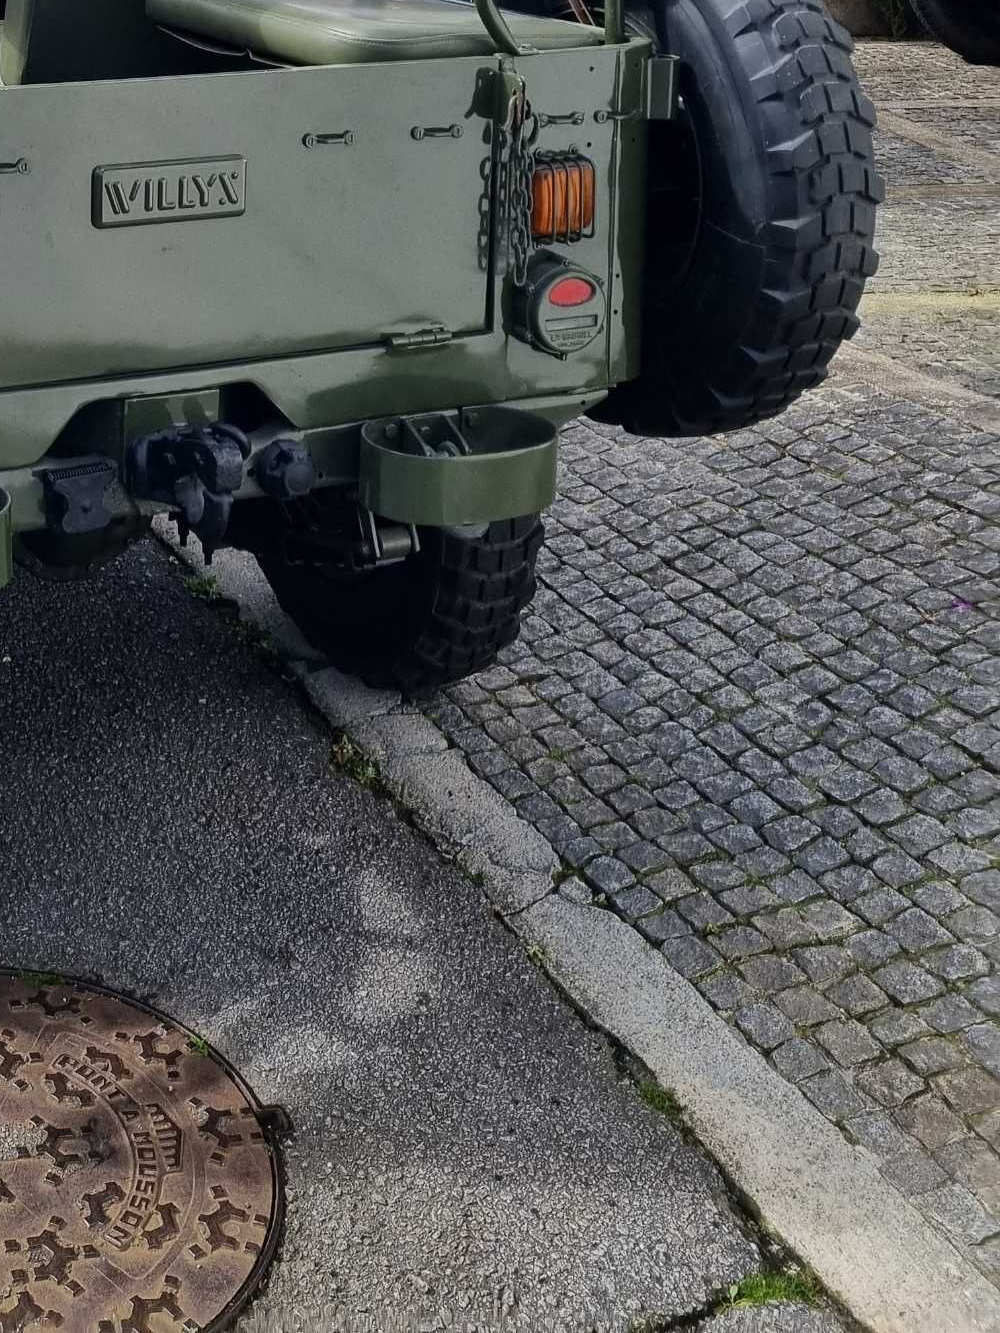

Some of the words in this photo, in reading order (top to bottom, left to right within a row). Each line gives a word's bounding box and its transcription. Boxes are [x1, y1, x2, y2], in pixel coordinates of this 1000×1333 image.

[55, 1055, 125, 1102] PONT
[120, 1110, 139, 1122] A
[105, 1131, 158, 1247] MOUSSON
